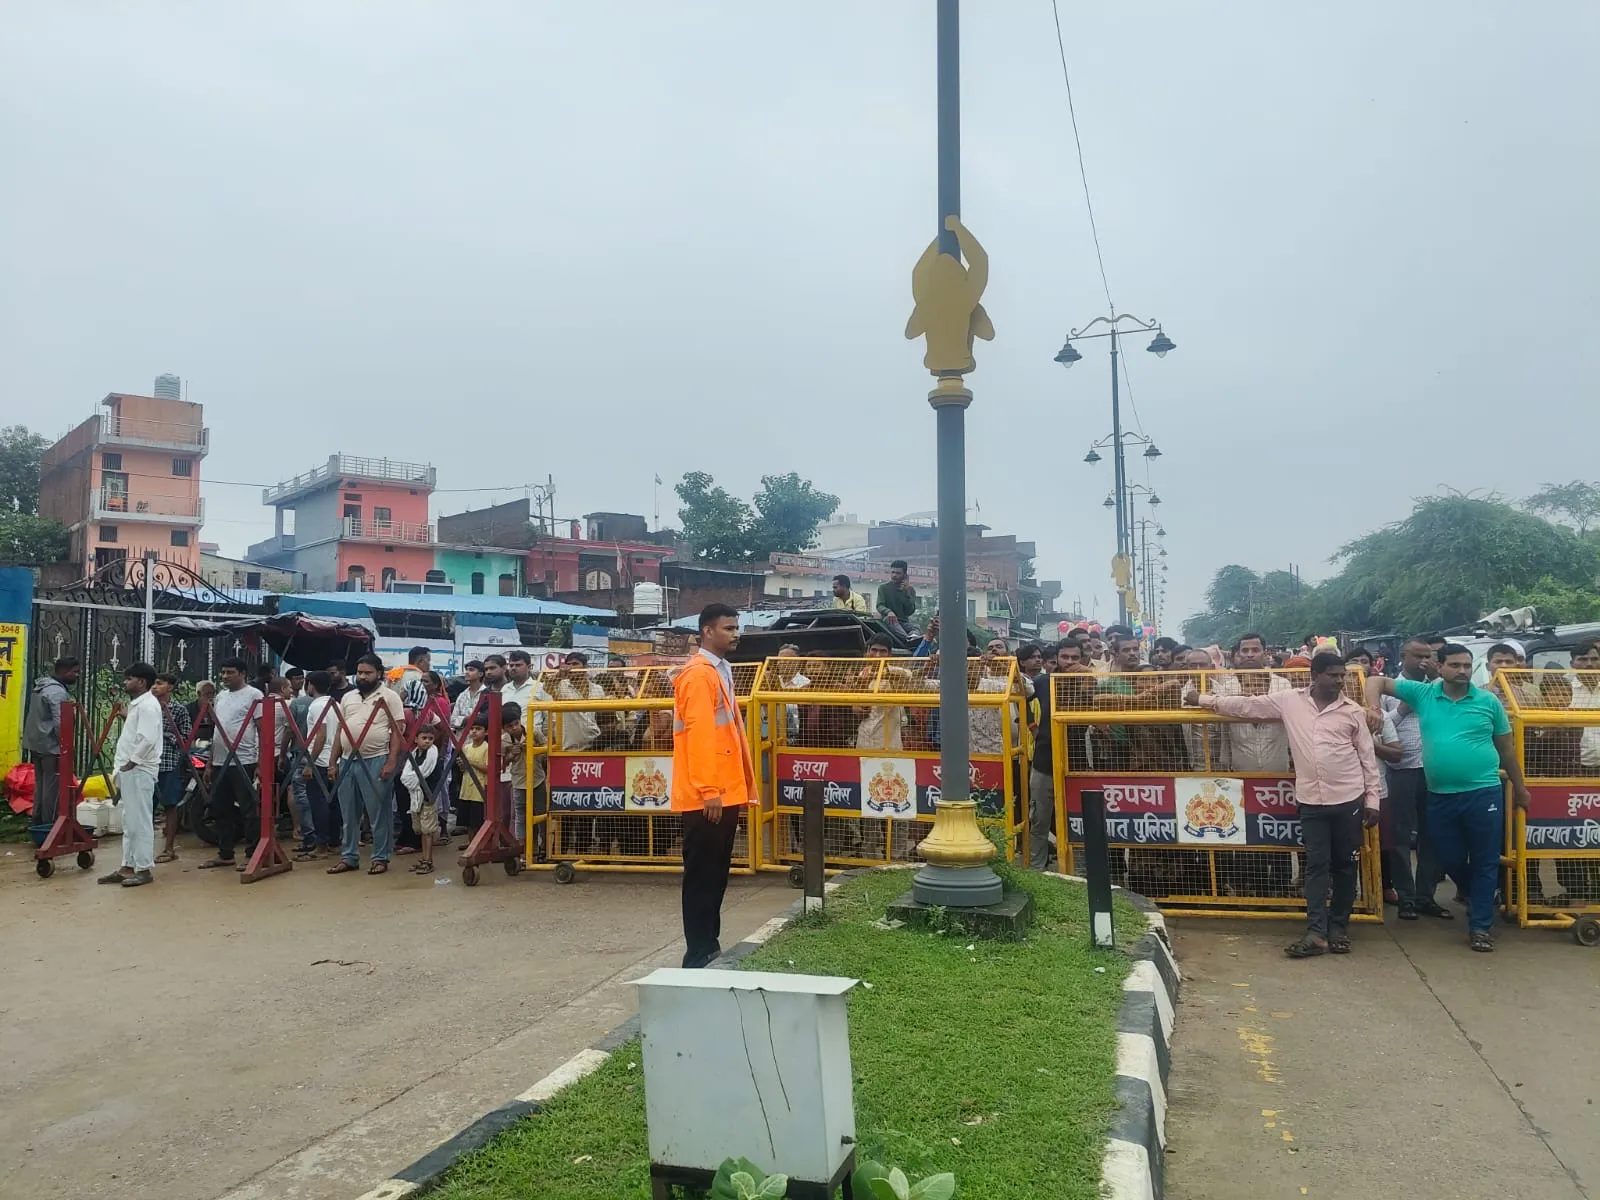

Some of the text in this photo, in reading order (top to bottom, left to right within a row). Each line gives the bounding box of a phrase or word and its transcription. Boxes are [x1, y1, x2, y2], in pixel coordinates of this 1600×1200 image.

[571, 761, 604, 784] कृपया
[792, 760, 829, 781] कृपया
[551, 790, 590, 807] यातायात
[593, 786, 625, 808] पुलिस
[783, 785, 804, 803] याता
[1102, 784, 1165, 812] कृपया
[1132, 812, 1176, 843] पुलिस
